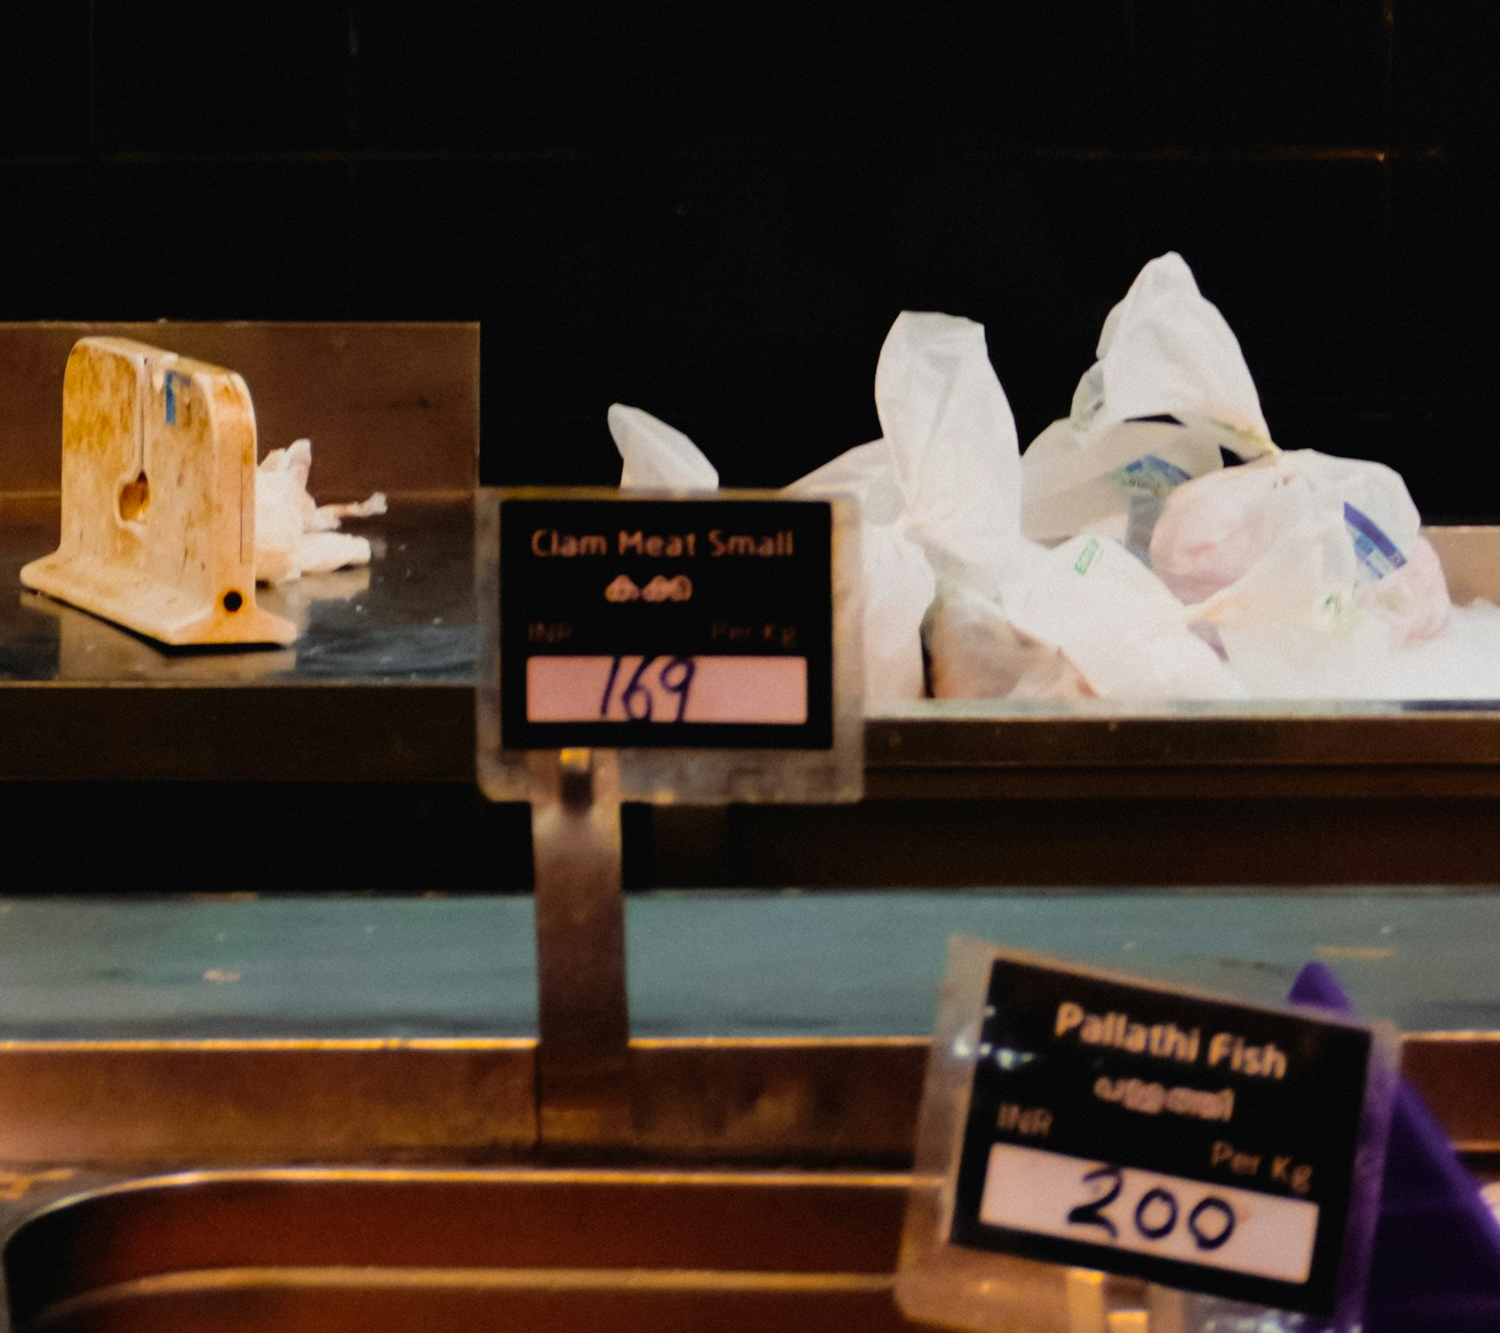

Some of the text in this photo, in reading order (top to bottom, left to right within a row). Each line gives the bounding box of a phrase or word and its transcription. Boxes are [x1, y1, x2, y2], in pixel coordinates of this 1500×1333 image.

[531, 528, 794, 559] Clam Meat Small
[711, 619, 752, 641] Per
[763, 621, 798, 649] Kg
[600, 654, 696, 725] 169
[1054, 1001, 1287, 1081] Pallathi Fish
[997, 1101, 1315, 1197] INR Per Kg
[1067, 1164, 1236, 1251] 200
